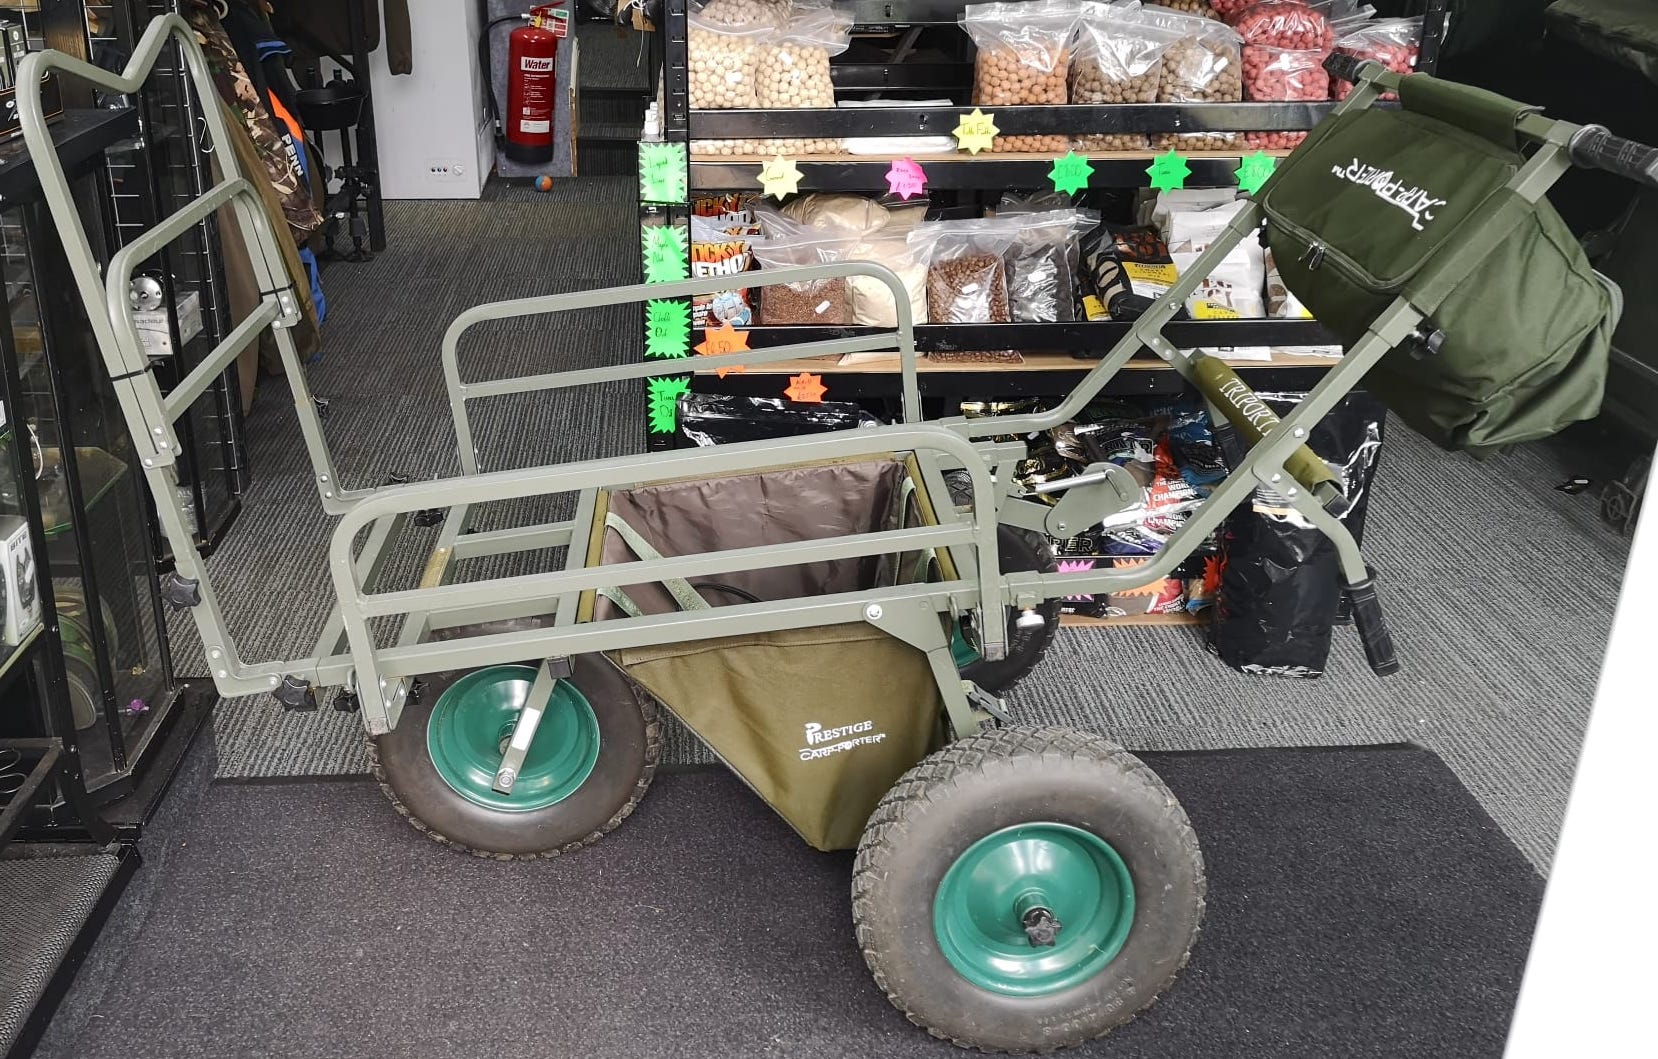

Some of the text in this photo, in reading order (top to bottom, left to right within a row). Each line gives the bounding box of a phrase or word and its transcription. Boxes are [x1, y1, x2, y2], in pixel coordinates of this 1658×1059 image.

[524, 58, 551, 70] Water
[281, 133, 305, 177] PENN
[804, 720, 873, 745] PRESTIGE
